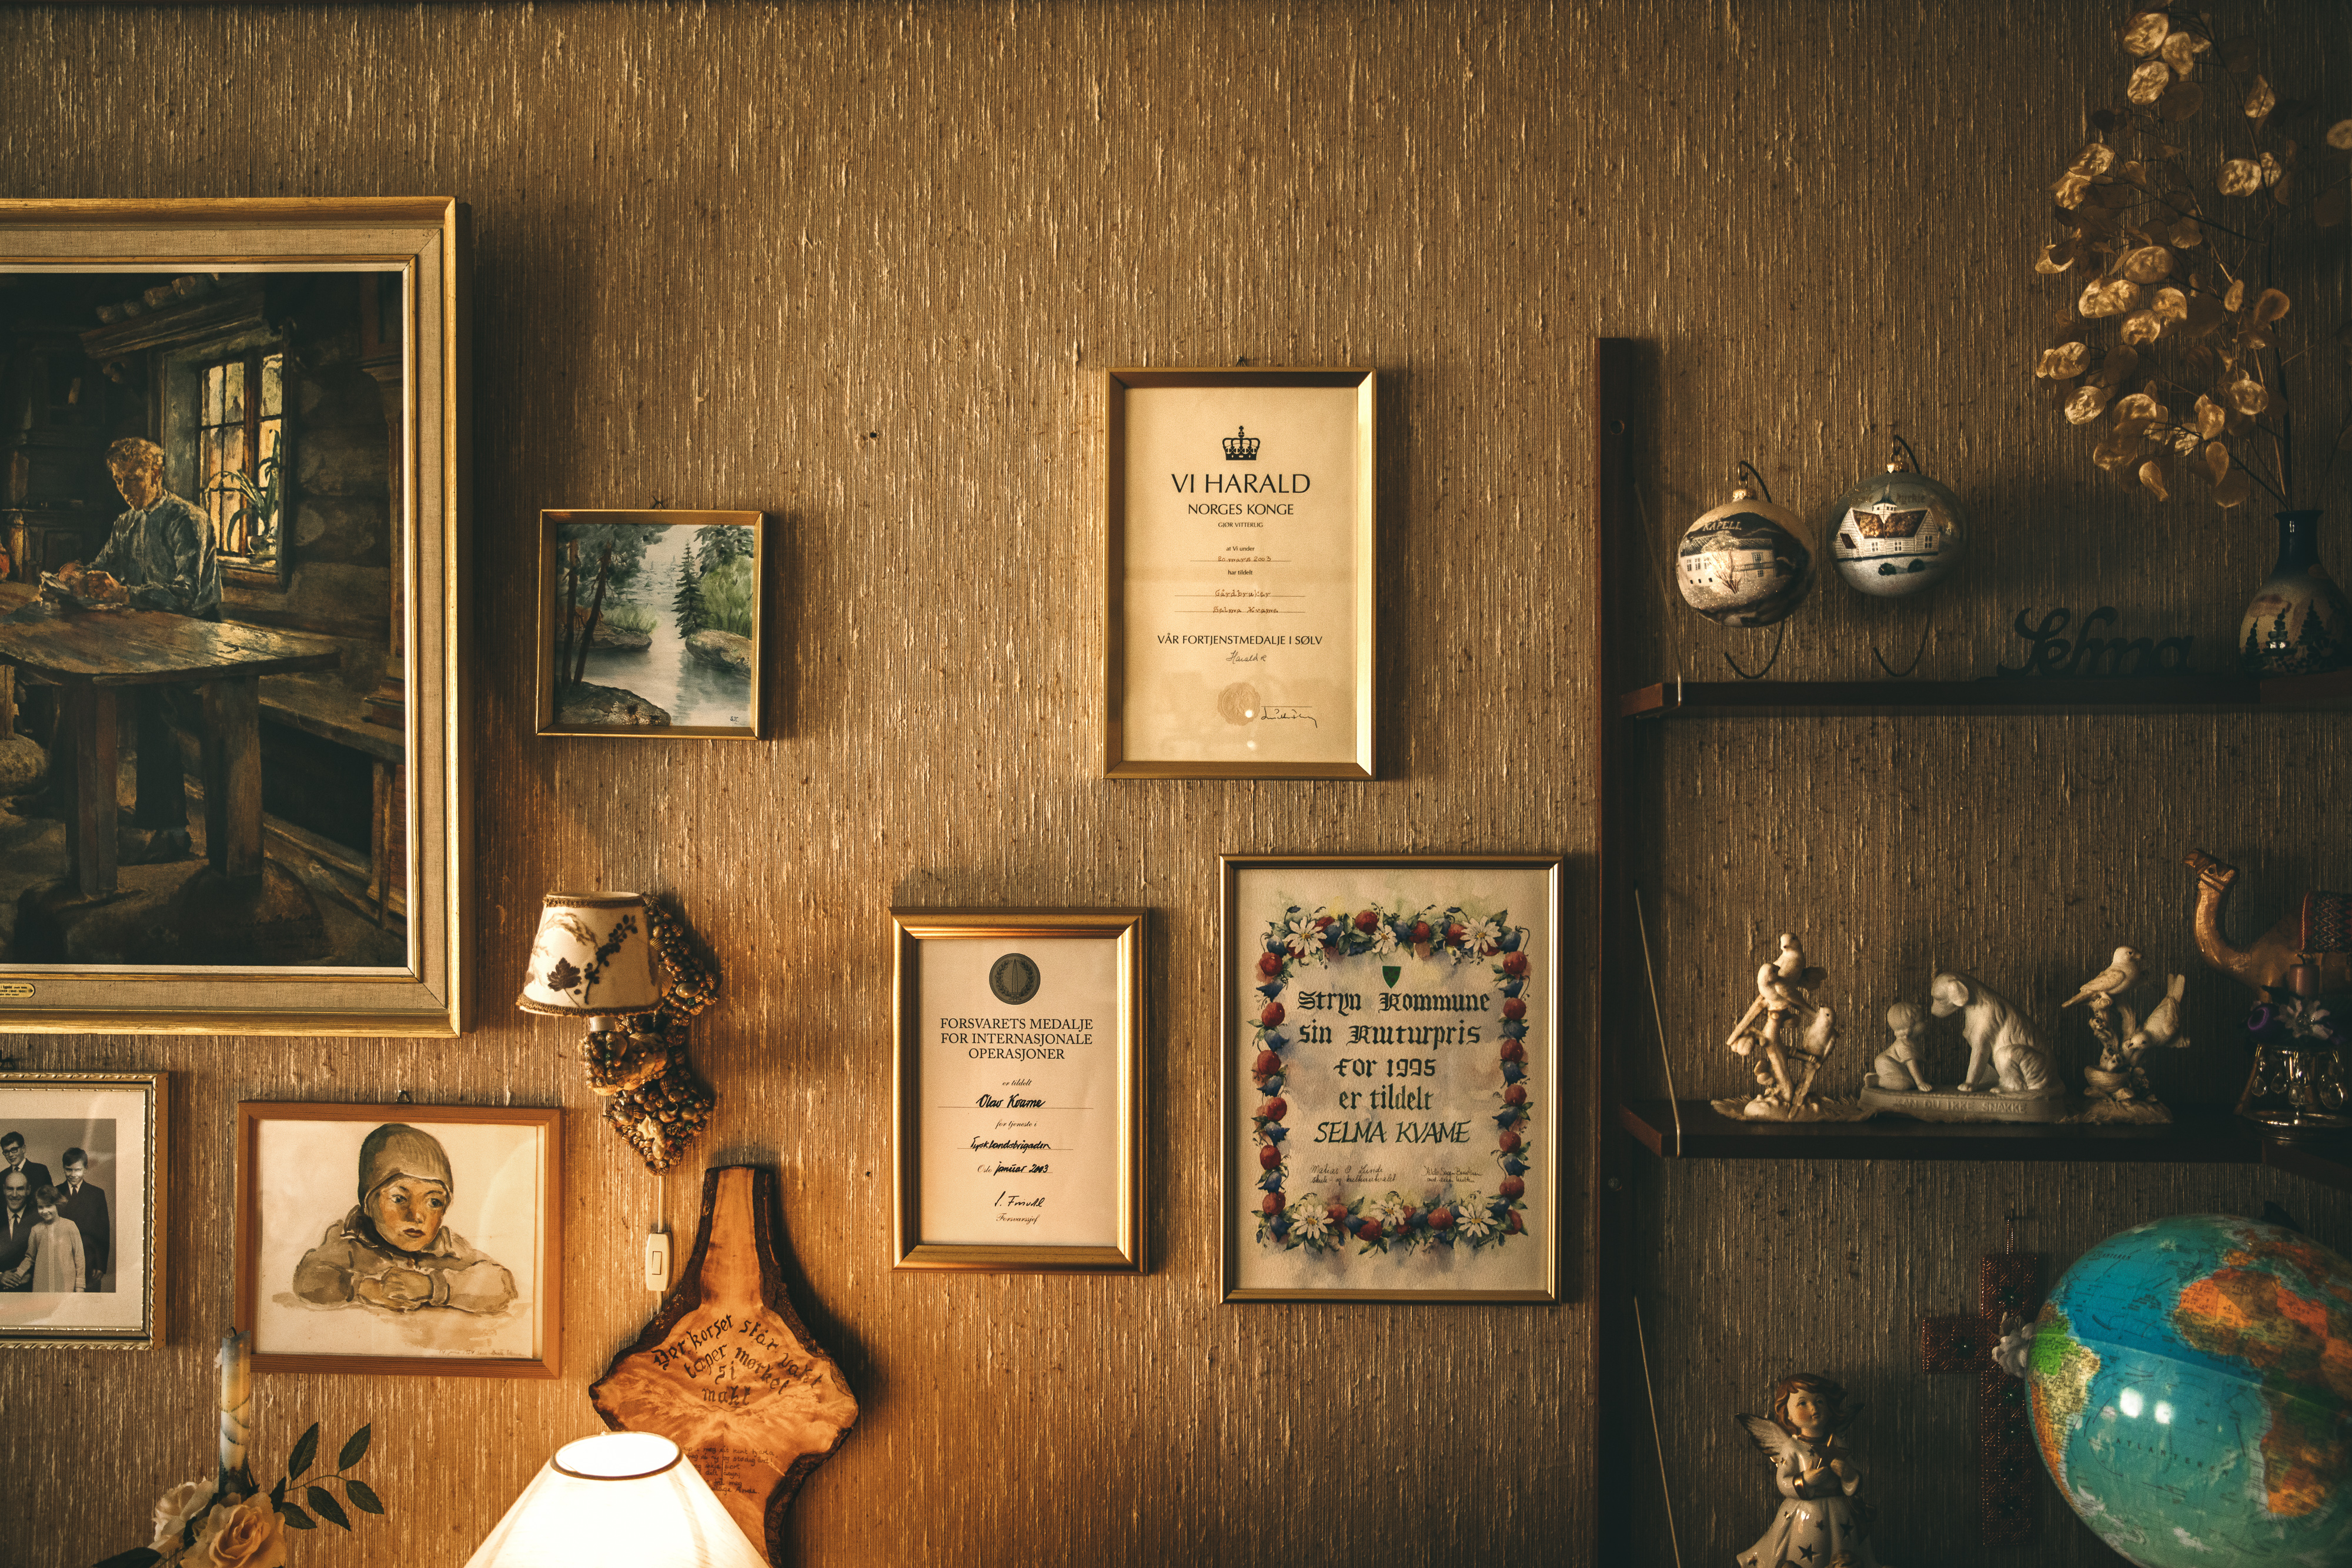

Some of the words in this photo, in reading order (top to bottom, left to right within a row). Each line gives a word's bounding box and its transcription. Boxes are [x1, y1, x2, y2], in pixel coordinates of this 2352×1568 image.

[1171, 474, 1194, 493] VI
[1205, 474, 1311, 493] HARALD
[1188, 503, 1242, 516] NORGES
[1247, 503, 1294, 516] KONGE
[1215, 589, 1271, 598] Gårdbruker
[1158, 633, 1180, 646] VÅR
[1182, 635, 1286, 646] FORTJENSTMEDALJE
[1289, 636, 1292, 645] I
[1294, 635, 1323, 646] SØLV
[1997, 606, 2197, 676] Selma
[1226, 650, 1258, 664] Harald
[1297, 991, 1361, 1017] Stryn
[1378, 992, 1490, 1012] Kommune
[940, 1018, 1026, 1030] FORSVARETS
[1029, 1018, 1094, 1032] MEDALJE
[1297, 1019, 1332, 1044] sin
[941, 1033, 969, 1044] FOR
[971, 1033, 1093, 1047] INTERNASJONALE
[968, 1048, 1065, 1061] OPERASJONER
[1387, 1058, 1436, 1078] 1995
[1011, 1078, 1032, 1086] tildelt
[975, 1094, 1004, 1108] Olav
[1007, 1093, 1046, 1108] Kvame
[1339, 1091, 1362, 1110] er
[1369, 1083, 1434, 1111] tildelt
[1923, 1099, 1940, 1109] DU
[1946, 1099, 1971, 1111] IKKE
[995, 1119, 1007, 1130] for
[1007, 1121, 1033, 1130] tjeneste
[1314, 1121, 1387, 1144] SELMA
[1395, 1120, 1471, 1144] KVAME
[970, 1136, 1051, 1154] Tysklandsbrigaden
[977, 1164, 993, 1174] Oslo
[993, 1161, 1028, 1176] januar
[1029, 1164, 1049, 1174] 2003
[996, 1213, 1040, 1225] Forsvarssjef
[651, 1337, 686, 1371] Der
[686, 1313, 735, 1350] korset
[683, 1343, 728, 1379] taper
[734, 1346, 790, 1396] mørket
[715, 1360, 737, 1385] si
[701, 1385, 751, 1407] makt
